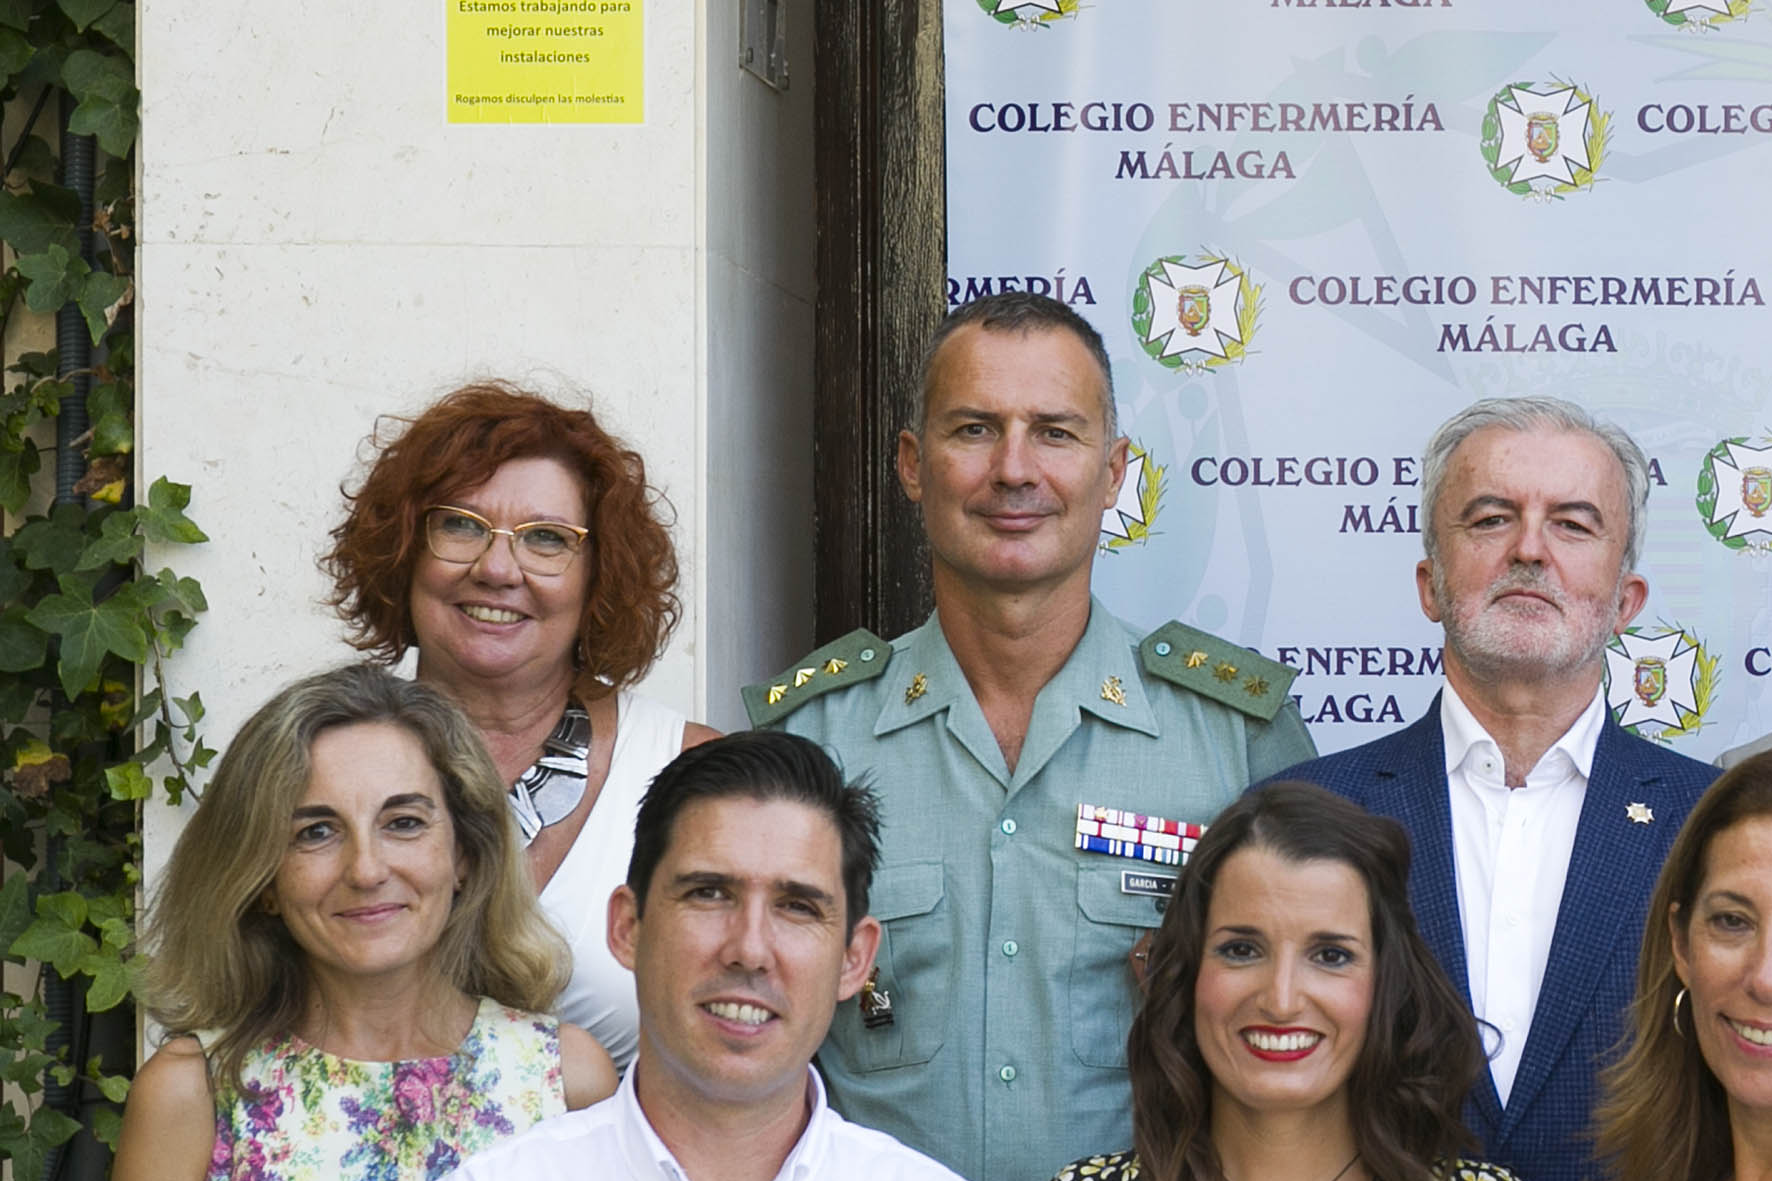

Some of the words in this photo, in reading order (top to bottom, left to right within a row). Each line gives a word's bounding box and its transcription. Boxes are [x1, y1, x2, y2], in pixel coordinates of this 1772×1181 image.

[459, 0, 516, 13] Estamos
[521, 0, 596, 15] trabajando
[601, 2, 631, 15] para
[486, 24, 541, 39] mejorar
[545, 25, 604, 37] nuestras
[500, 50, 590, 63] instalaciones
[455, 93, 503, 106] Rogamos
[505, 93, 555, 105] disculpen
[557, 93, 573, 104] las
[575, 94, 625, 104] molestias
[968, 102, 1155, 133] COLEGIO
[1168, 95, 1445, 133] ENFERMERÍA
[1115, 143, 1297, 180] MÁLAGA
[1288, 275, 1477, 307] COLEGIO
[1490, 269, 1766, 307] ENFERMERÍA
[1436, 316, 1619, 353] MÁLAGA
[1190, 456, 1380, 487] COLEGIO
